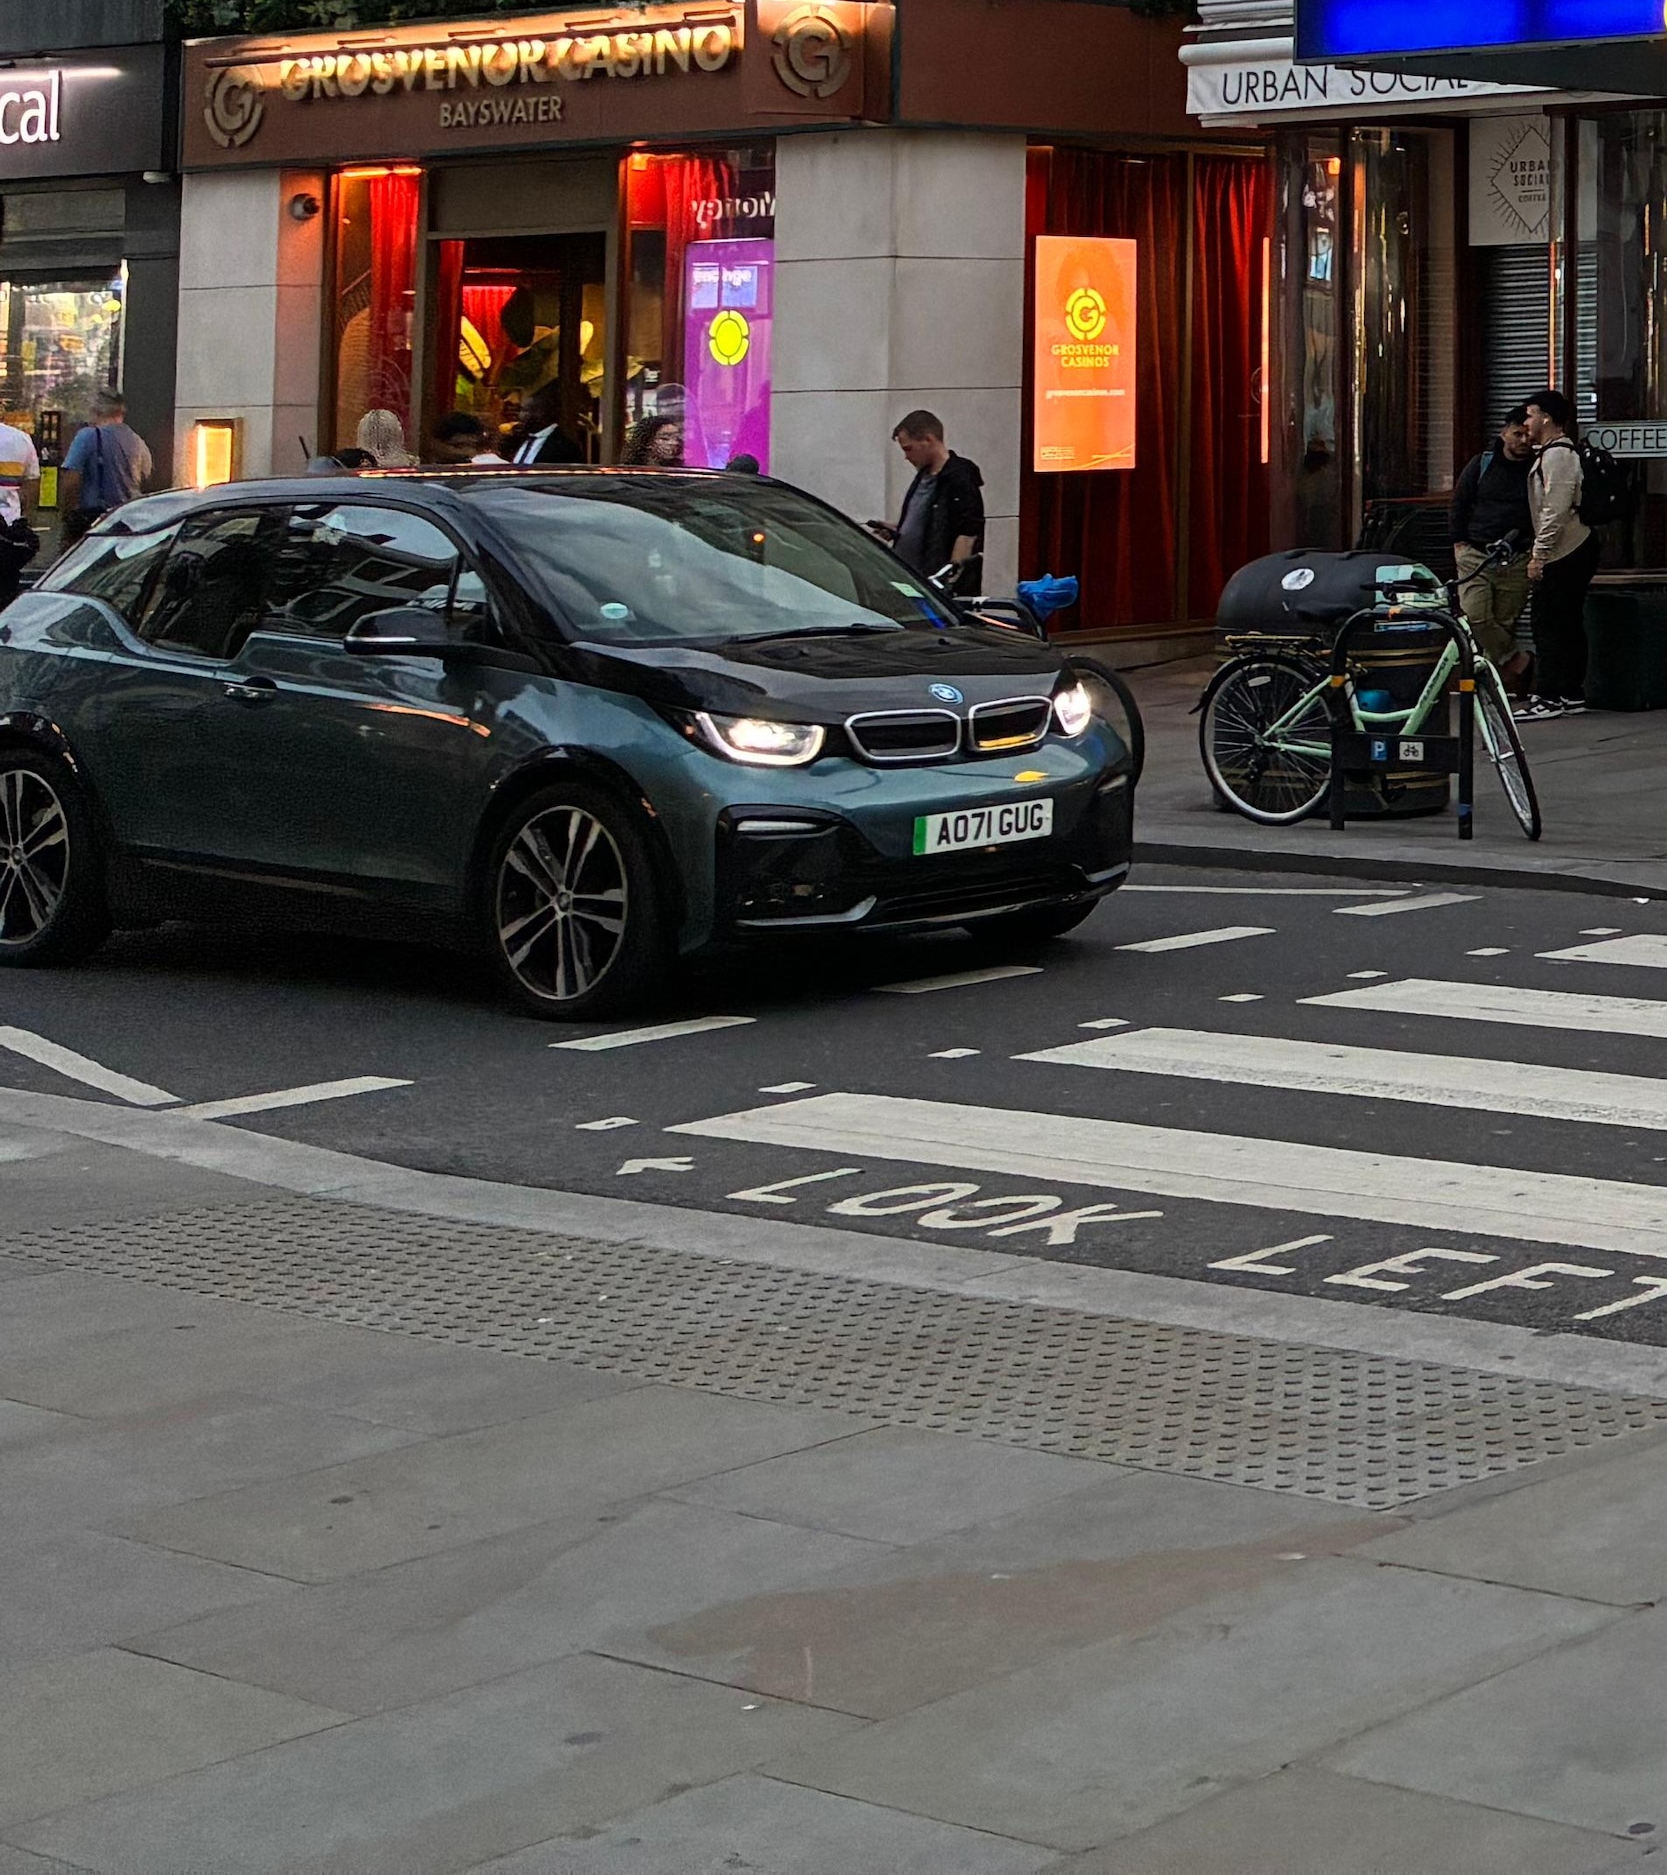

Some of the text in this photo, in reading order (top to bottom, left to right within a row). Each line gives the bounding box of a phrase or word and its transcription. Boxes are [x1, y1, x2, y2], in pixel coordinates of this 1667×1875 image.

[279, 25, 732, 101] GROSVENOR CASINO
[1222, 67, 1328, 105] URBAN
[439, 95, 562, 127] BAYSWATER
[1051, 343, 1120, 357] GROSVENOR
[1060, 356, 1111, 368] CASINOS
[1373, 741, 1385, 758] P
[937, 803, 1044, 845] AO71 GUG
[723, 1167, 1165, 1247] LOOK
